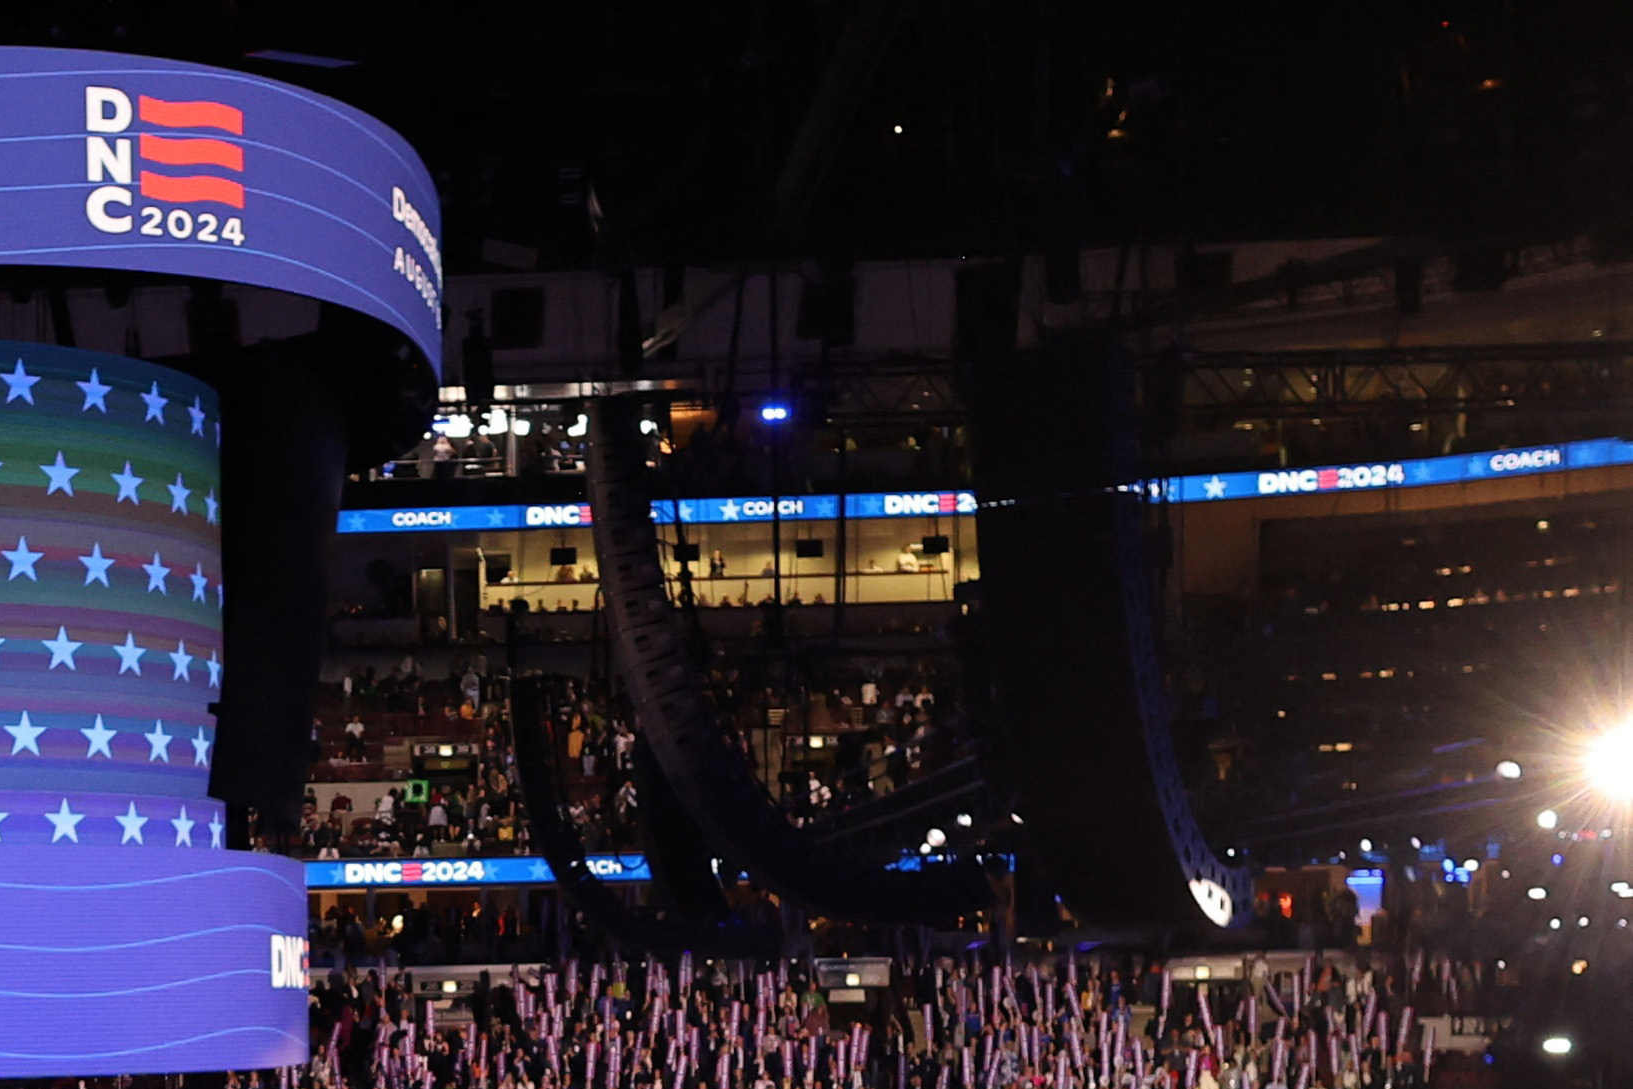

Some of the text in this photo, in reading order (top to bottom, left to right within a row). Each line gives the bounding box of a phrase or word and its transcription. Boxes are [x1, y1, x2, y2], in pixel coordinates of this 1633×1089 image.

[85, 86, 134, 233] DNC
[141, 206, 246, 246] 2024
[1489, 449, 1561, 472] COACH
[1258, 463, 1405, 494] DNC 2024
[526, 505, 580, 526] DNC
[884, 493, 939, 515] DNC
[392, 509, 452, 527] COACH
[345, 860, 485, 884] DNC 2024
